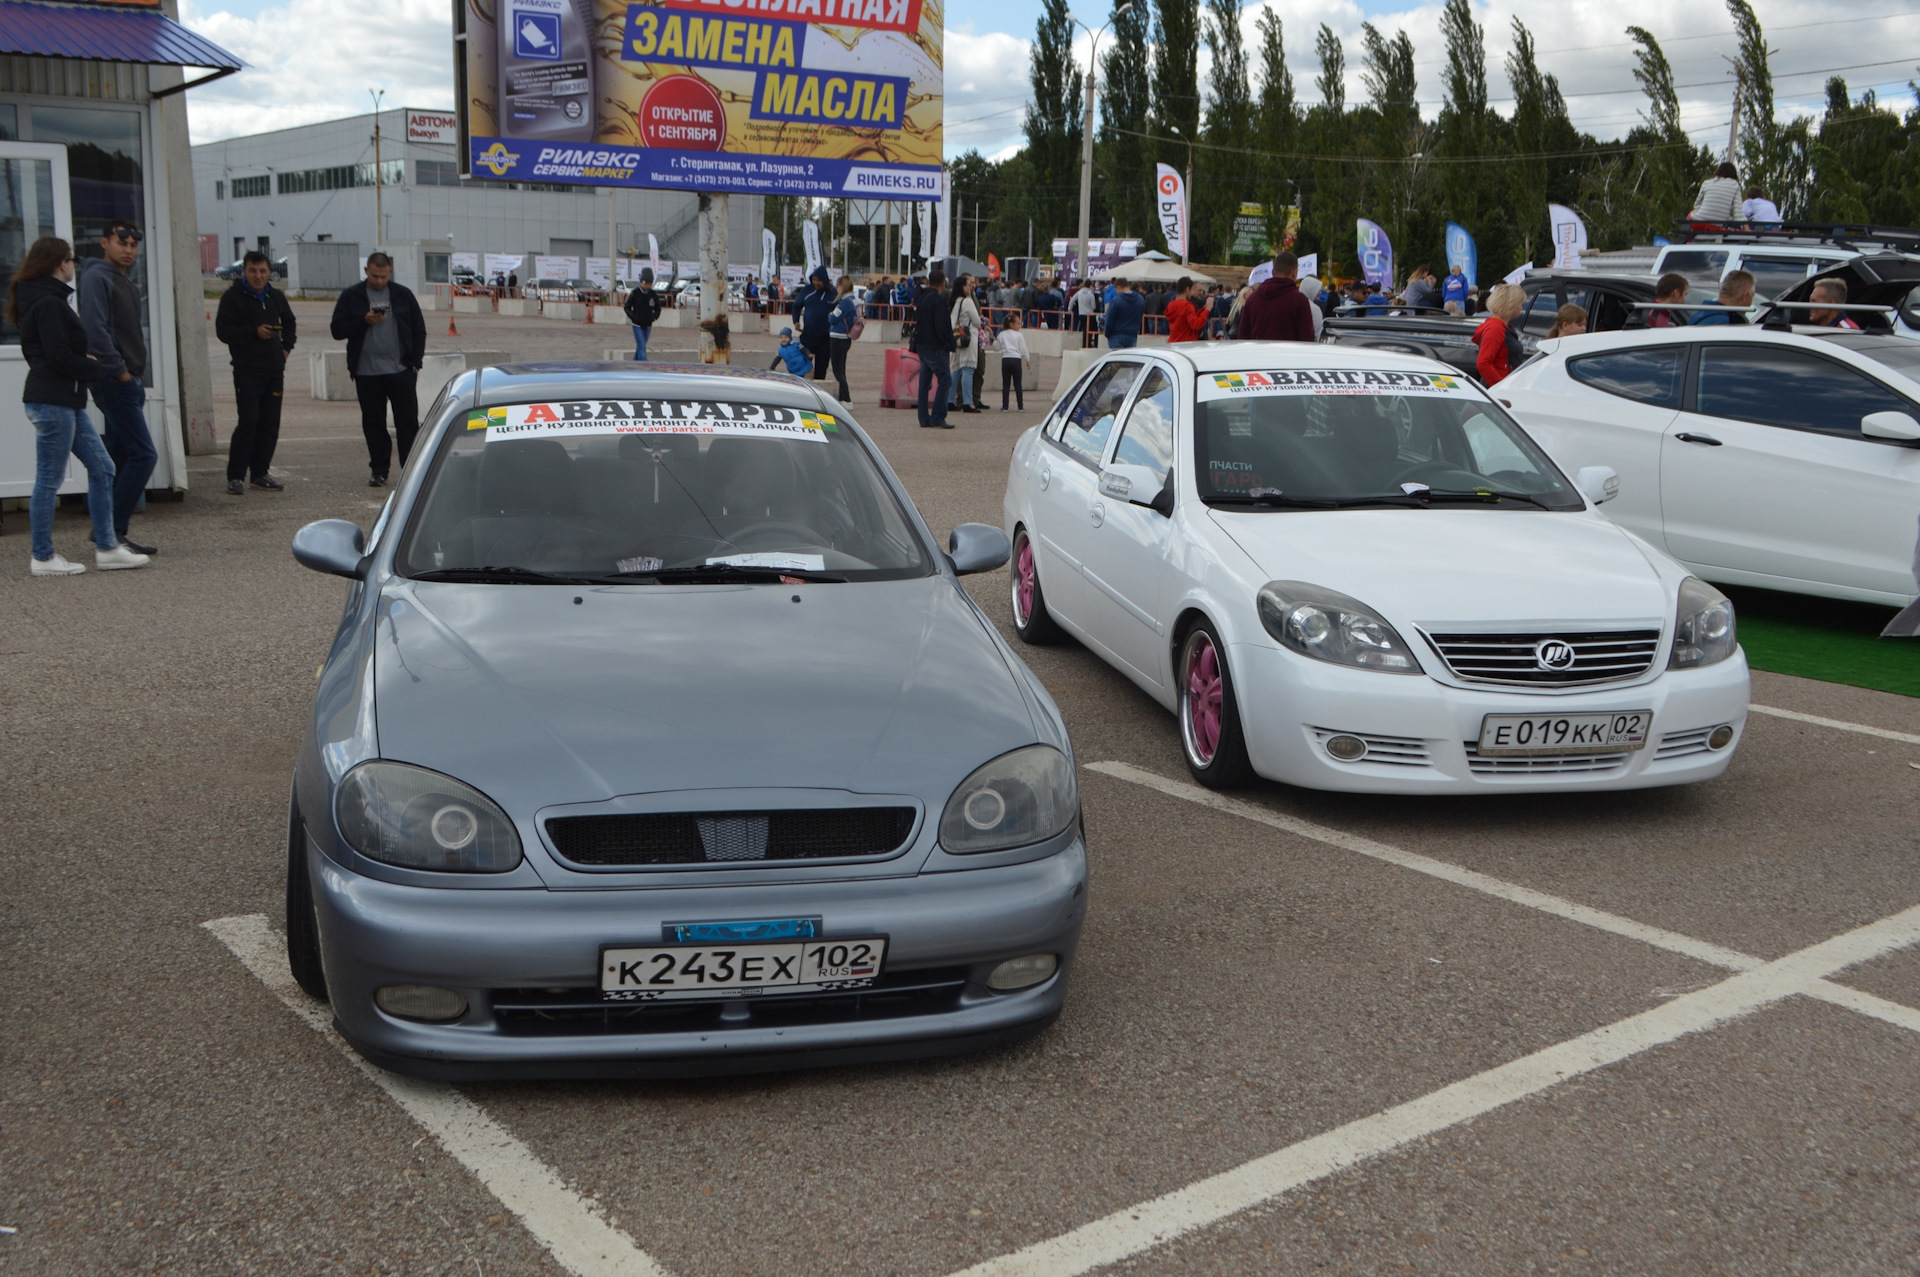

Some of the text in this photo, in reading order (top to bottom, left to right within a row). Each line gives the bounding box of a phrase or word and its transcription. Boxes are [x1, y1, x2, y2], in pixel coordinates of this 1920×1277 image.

[632, 12, 795, 67] ЗАМЕНА
[761, 73, 895, 122] МАСЛА
[652, 105, 713, 123] ОТКРЫТИЕ
[409, 128, 439, 140] Выкуп
[649, 125, 717, 141] 1 СЕНТЯБРЯ
[538, 148, 641, 168] РИМЭКС
[671, 157, 814, 176] г. Стерлитамак, ул. Лазурная, 2
[533, 164, 634, 179] СЕРВИСМАРКЕТ
[651, 172, 683, 183] Магазин:
[684, 175, 693, 184] +7
[694, 175, 716, 185] (3473)
[774, 179, 782, 188] +7
[783, 179, 804, 190] (3473)
[805, 181, 832, 191] 279-004
[857, 173, 935, 190] RIMEKS.RU
[1378, 385, 1450, 393] АВТОЗАПЧАСТИ
[496, 423, 544, 434] ЦЕНТР
[547, 420, 629, 430] КУЗОВНОГО
[633, 419, 698, 428] РЕМОНТА
[712, 421, 817, 435] АВТОЗАПЧАСТИ
[615, 426, 714, 434] www.avd-parts.ru
[1494, 715, 1641, 745] Е019КК 02
[1609, 734, 1628, 742] RUS
[619, 944, 872, 985] К243ЕХ 102
[818, 966, 849, 977] RUS
